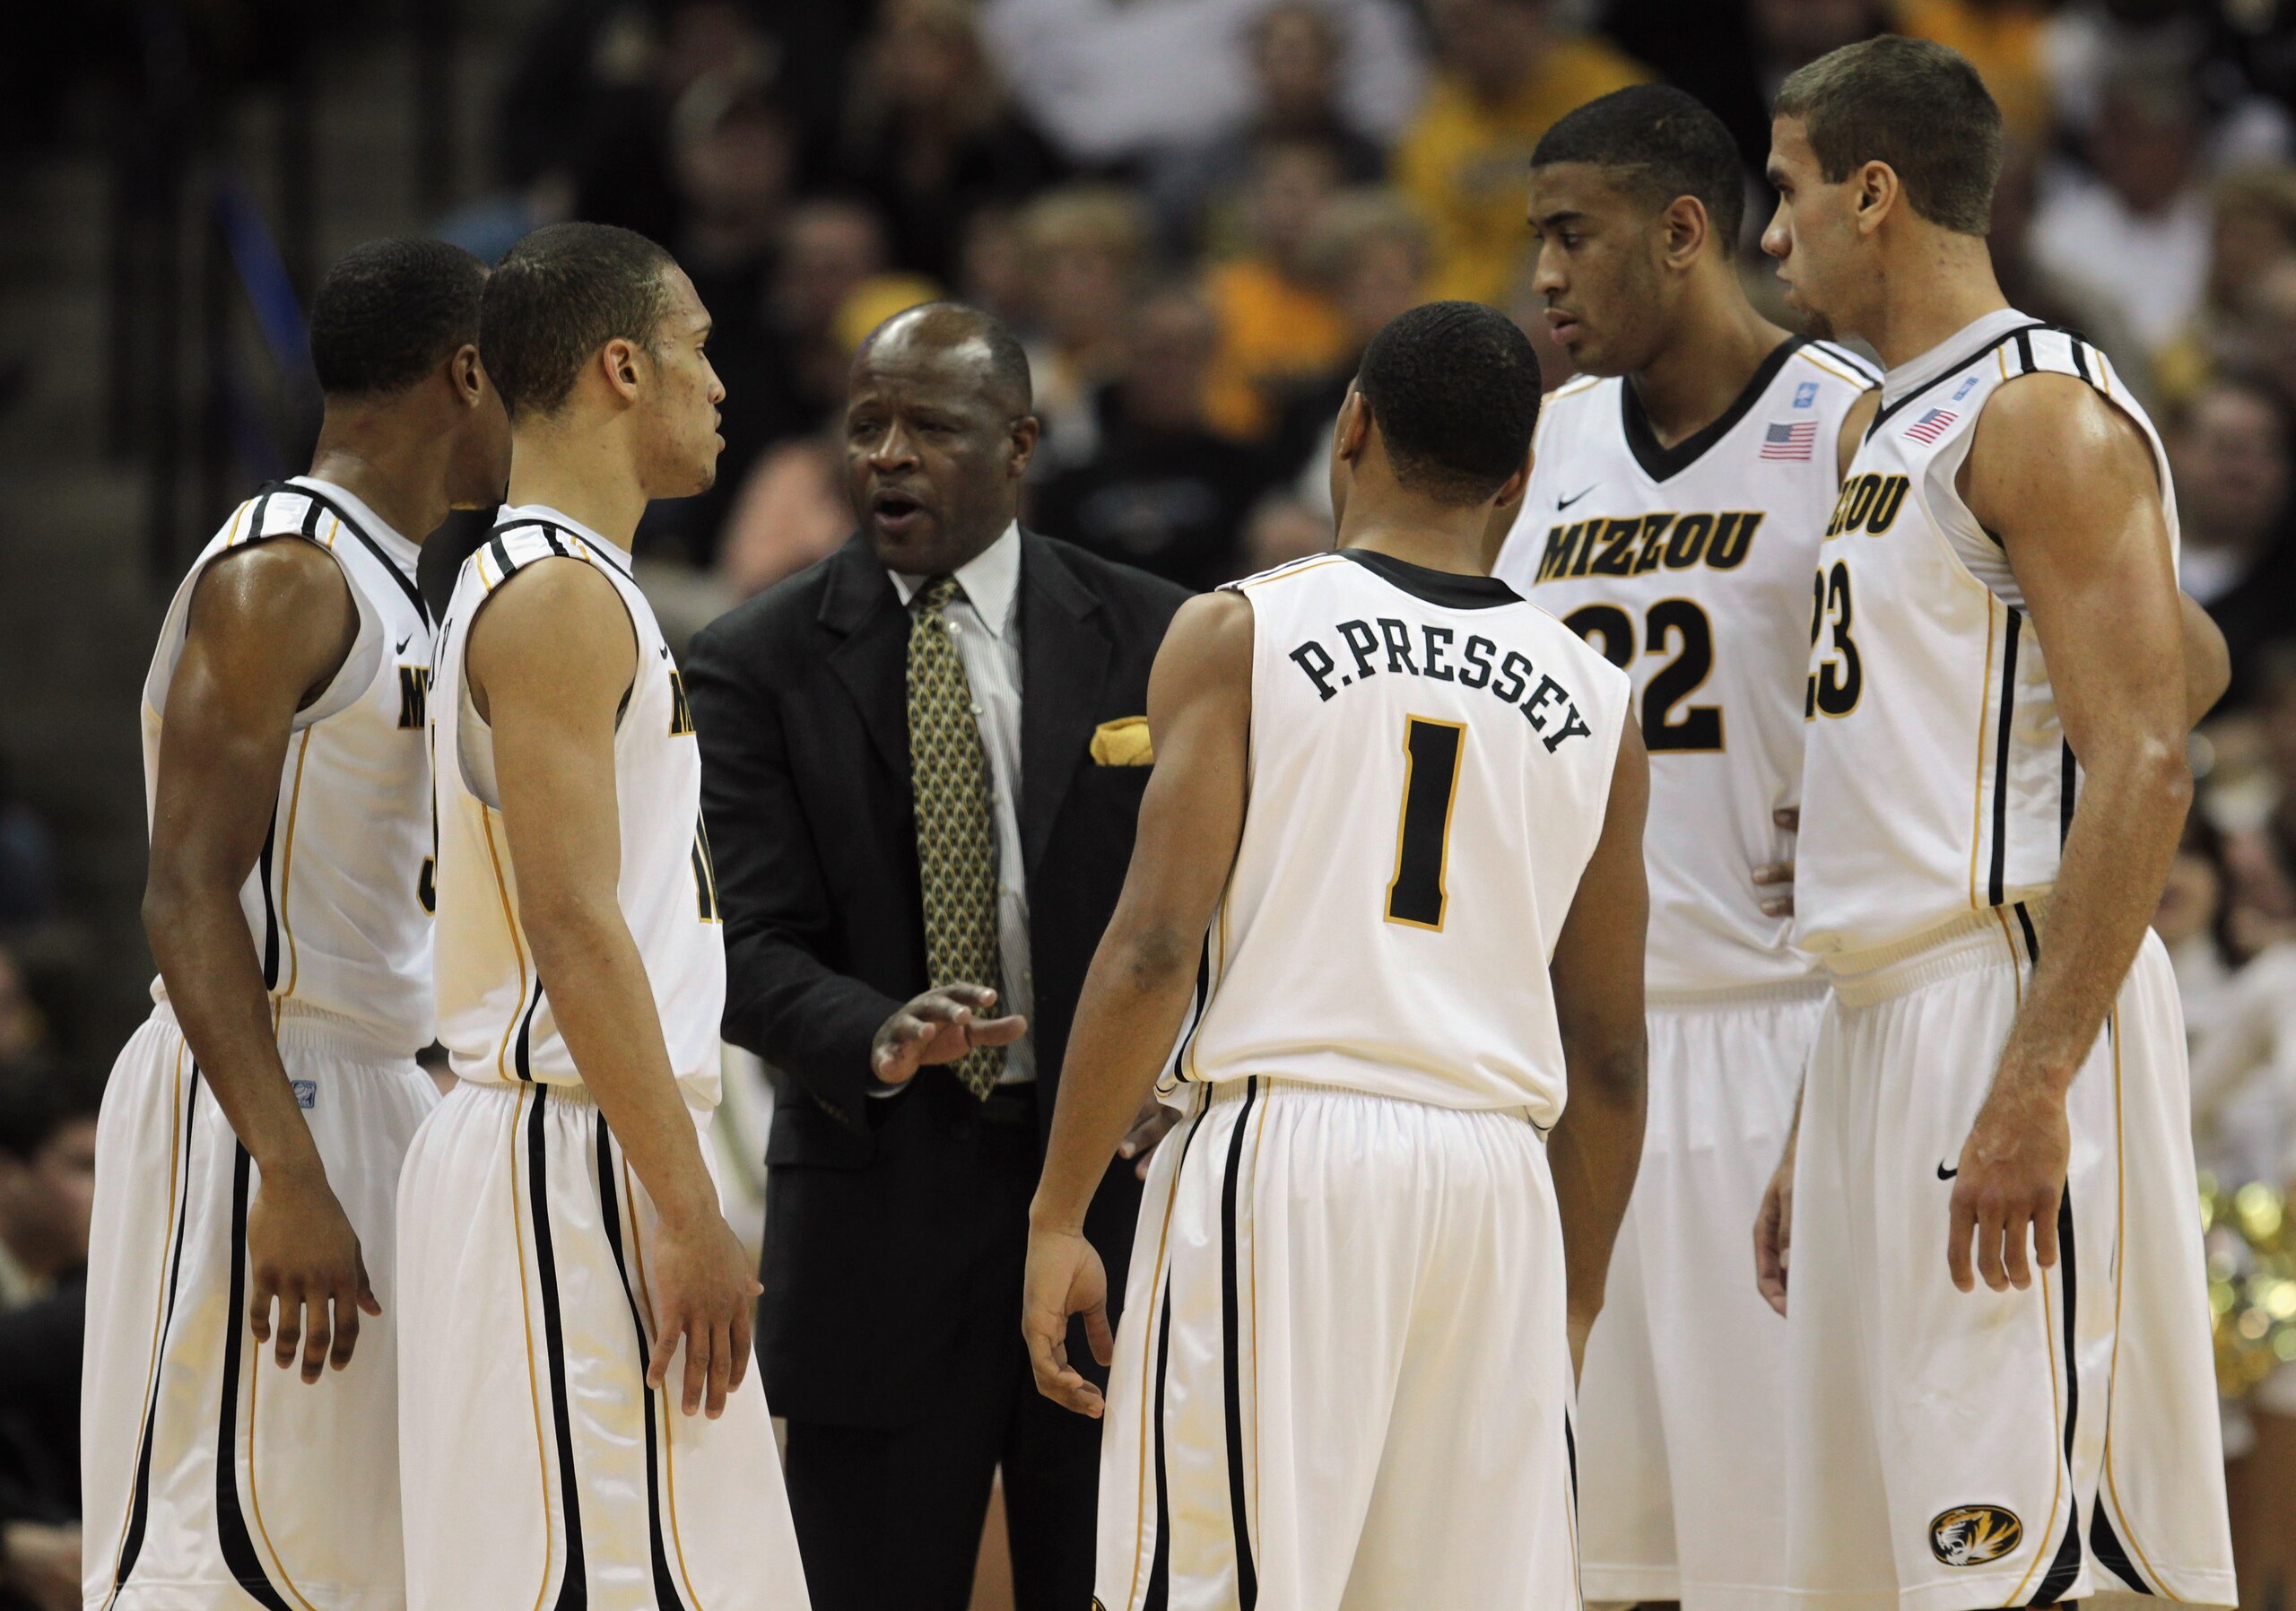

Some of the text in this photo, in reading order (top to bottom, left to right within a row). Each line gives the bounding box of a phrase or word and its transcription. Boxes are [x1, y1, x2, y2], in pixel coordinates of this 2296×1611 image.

[1535, 511, 1766, 585] MIZZOU
[1290, 617, 1591, 753] P.PRESSEY
[1383, 713, 1468, 933] 1
